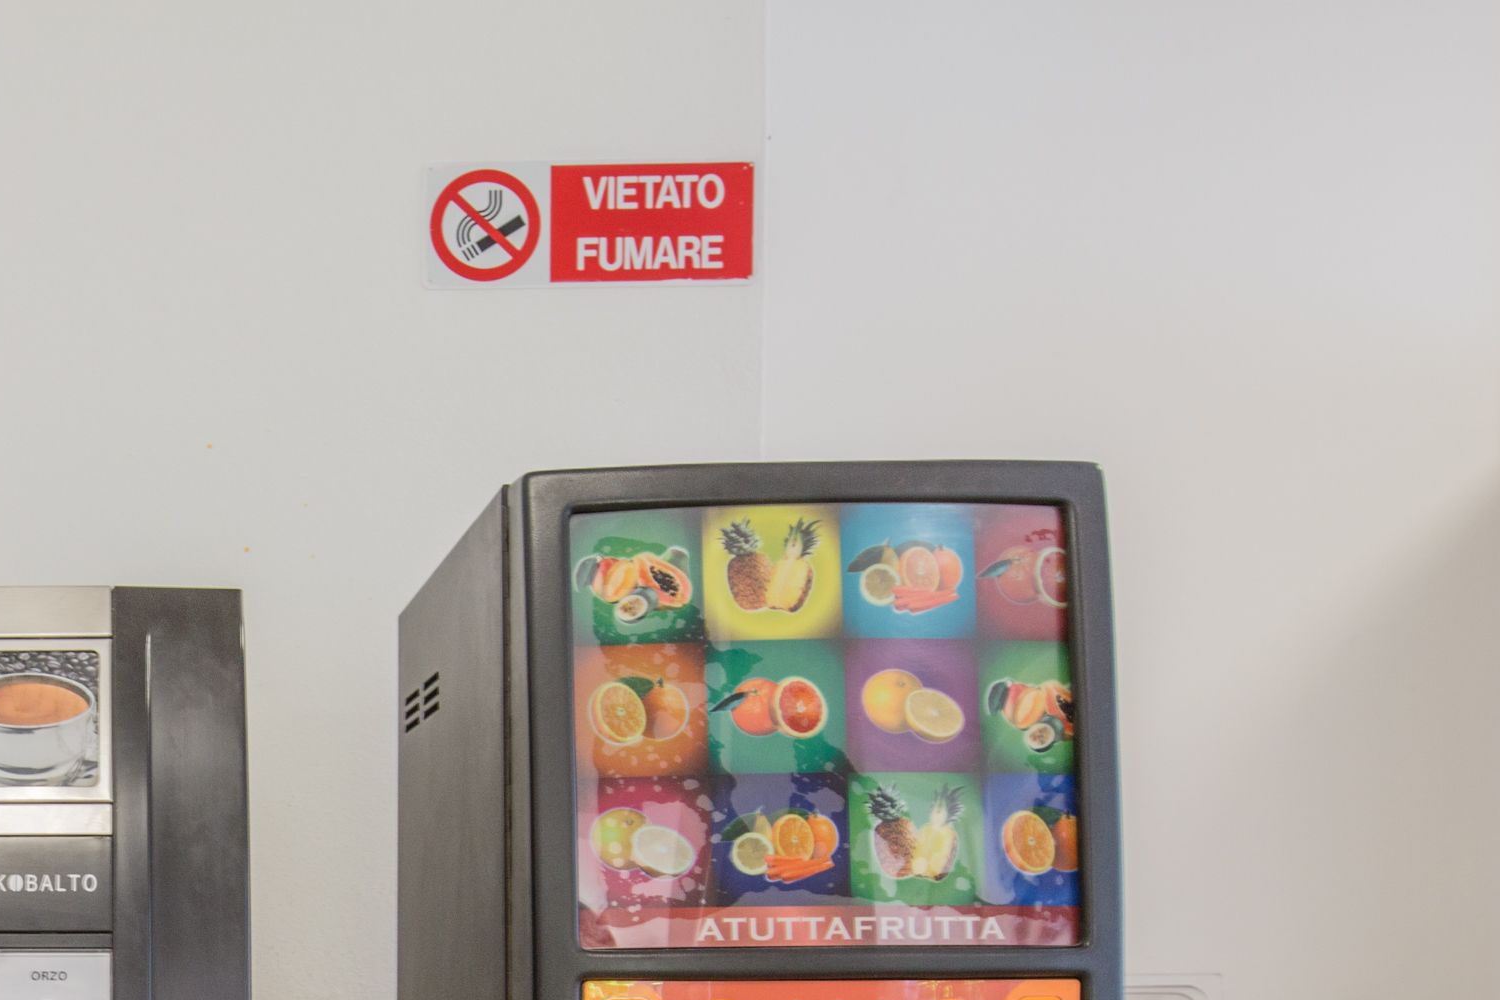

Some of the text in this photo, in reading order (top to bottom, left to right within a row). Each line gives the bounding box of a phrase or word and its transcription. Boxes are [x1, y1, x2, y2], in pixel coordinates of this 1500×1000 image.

[583, 173, 725, 210] VIETATO
[576, 235, 724, 271] FUMARE
[700, 916, 1005, 941] ATUTTAFRUTTA
[31, 970, 68, 981] ORZO
